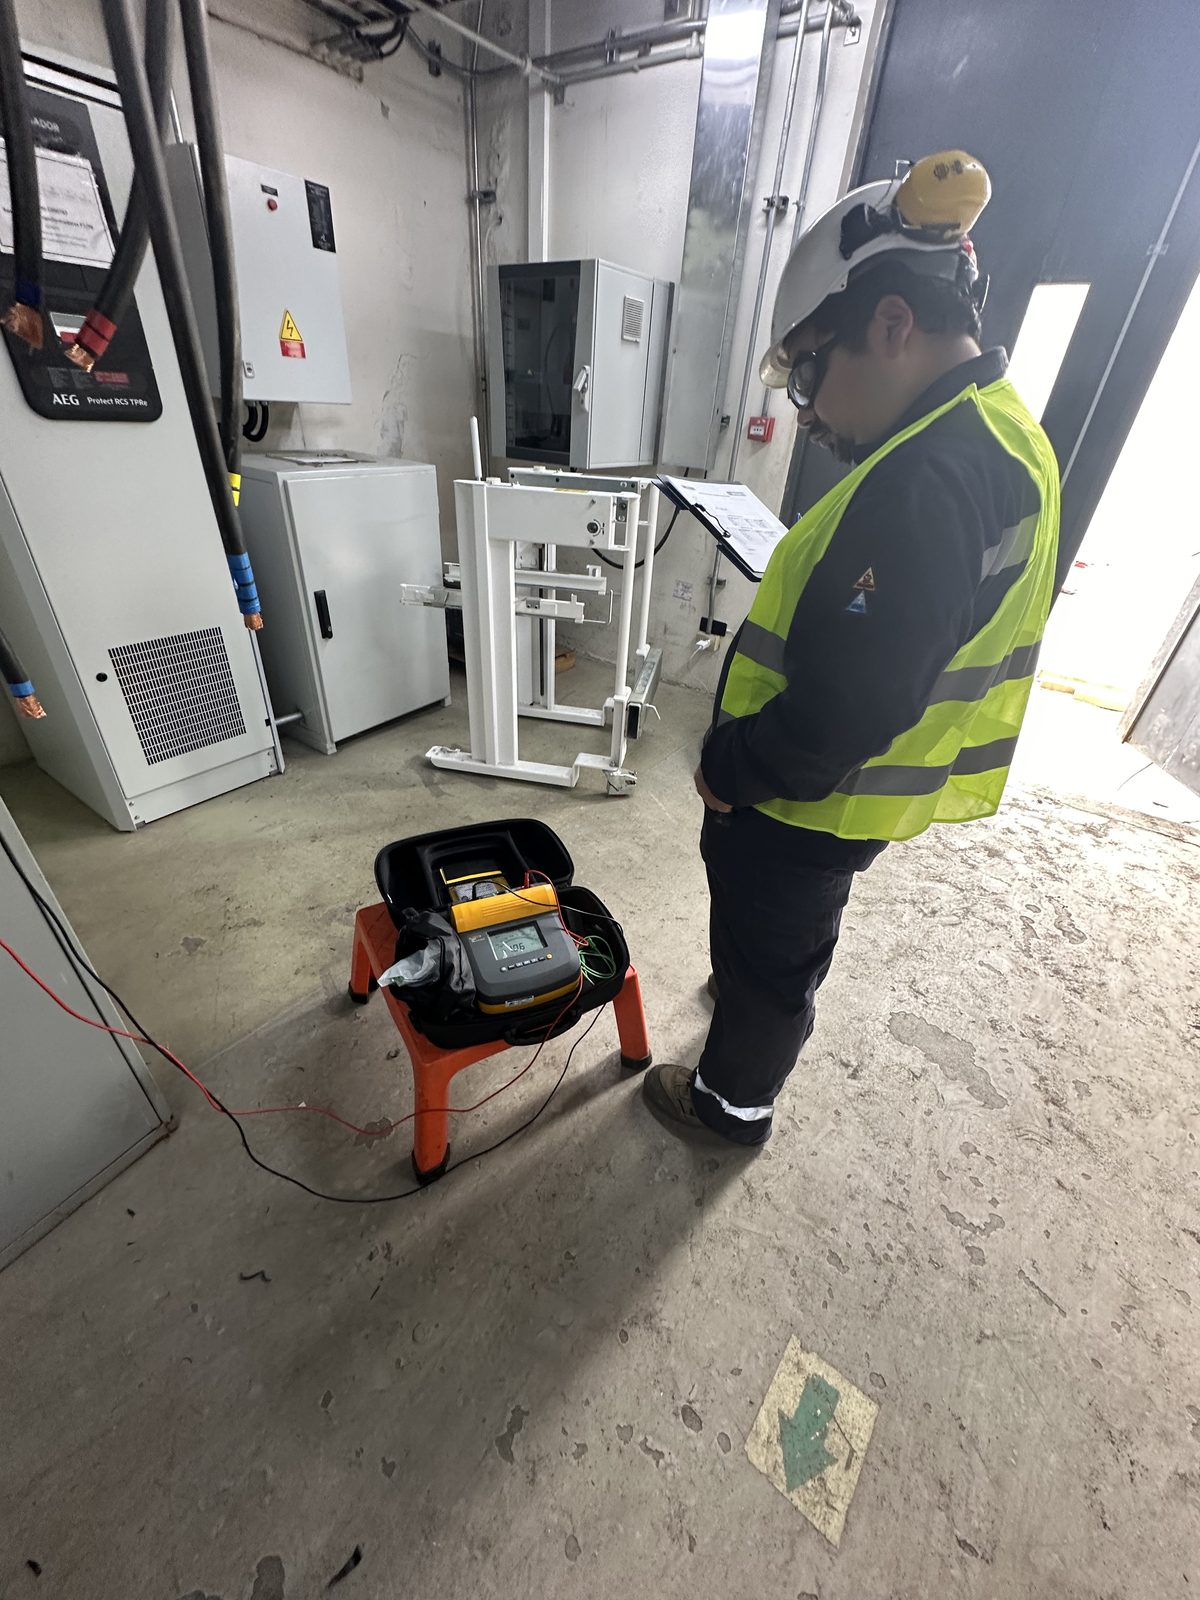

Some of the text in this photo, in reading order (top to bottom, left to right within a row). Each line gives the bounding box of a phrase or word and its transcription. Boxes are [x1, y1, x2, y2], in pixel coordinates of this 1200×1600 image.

[53, 393, 80, 406] AEG
[87, 396, 113, 405] Protect
[115, 398, 128, 406] RCS
